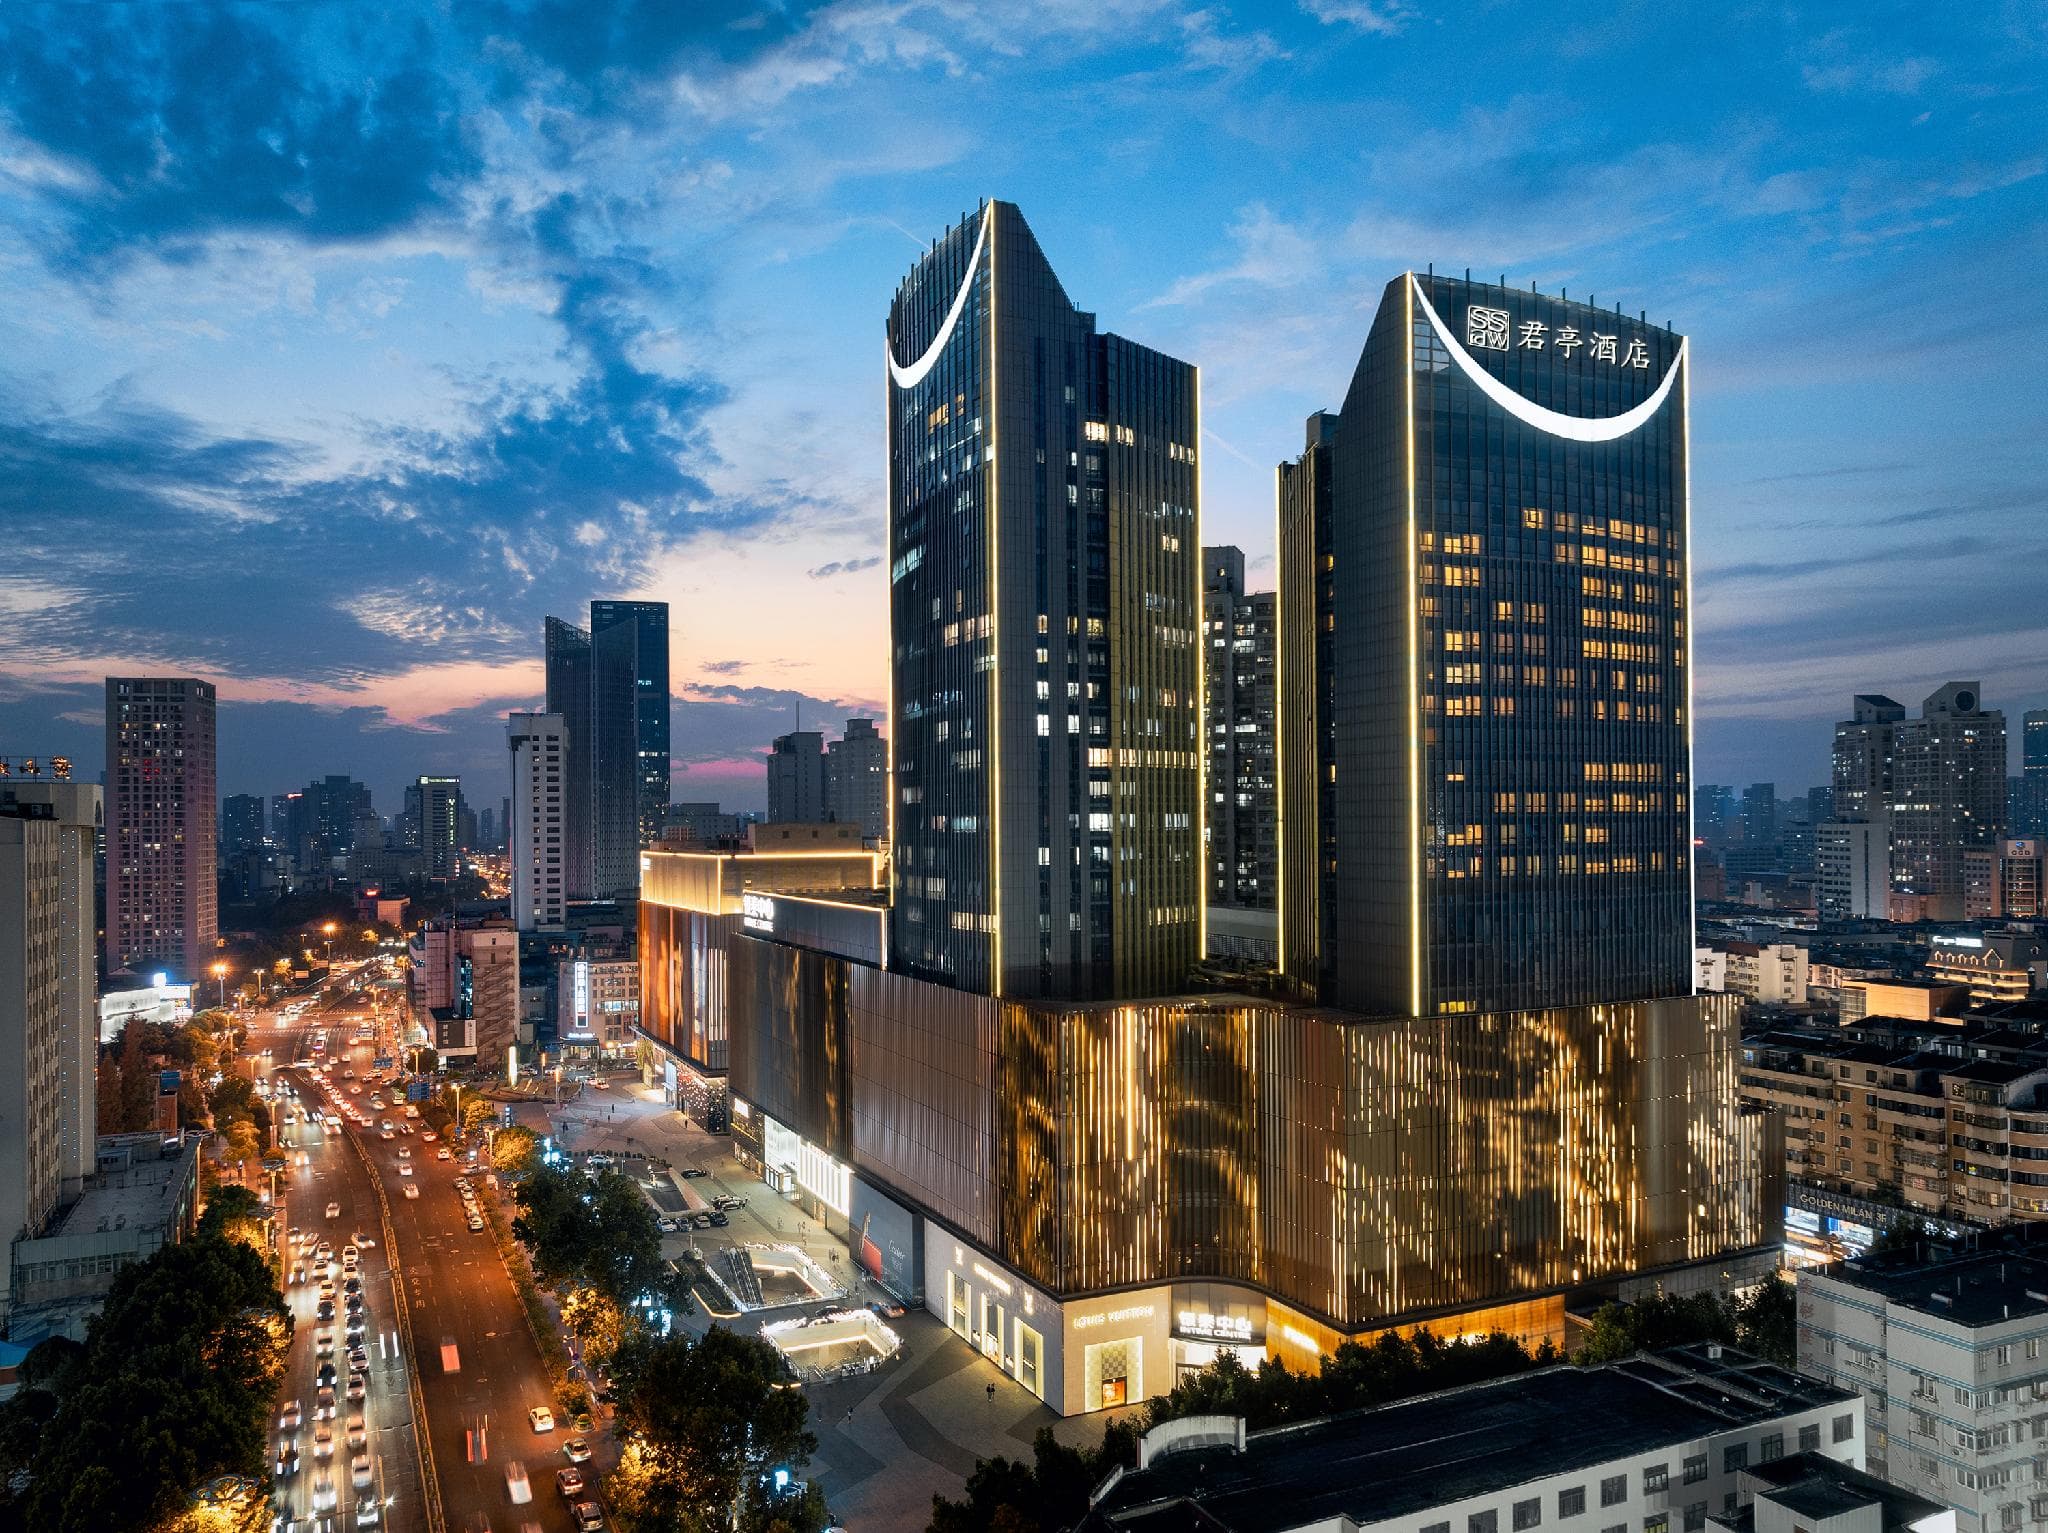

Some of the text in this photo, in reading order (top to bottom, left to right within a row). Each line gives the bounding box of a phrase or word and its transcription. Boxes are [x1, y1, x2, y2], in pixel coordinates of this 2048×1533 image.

[1517, 320, 1650, 369] 君亭酒店
[1799, 1194, 1840, 1212] GOLDEN
[1841, 1204, 1873, 1221] MILAN
